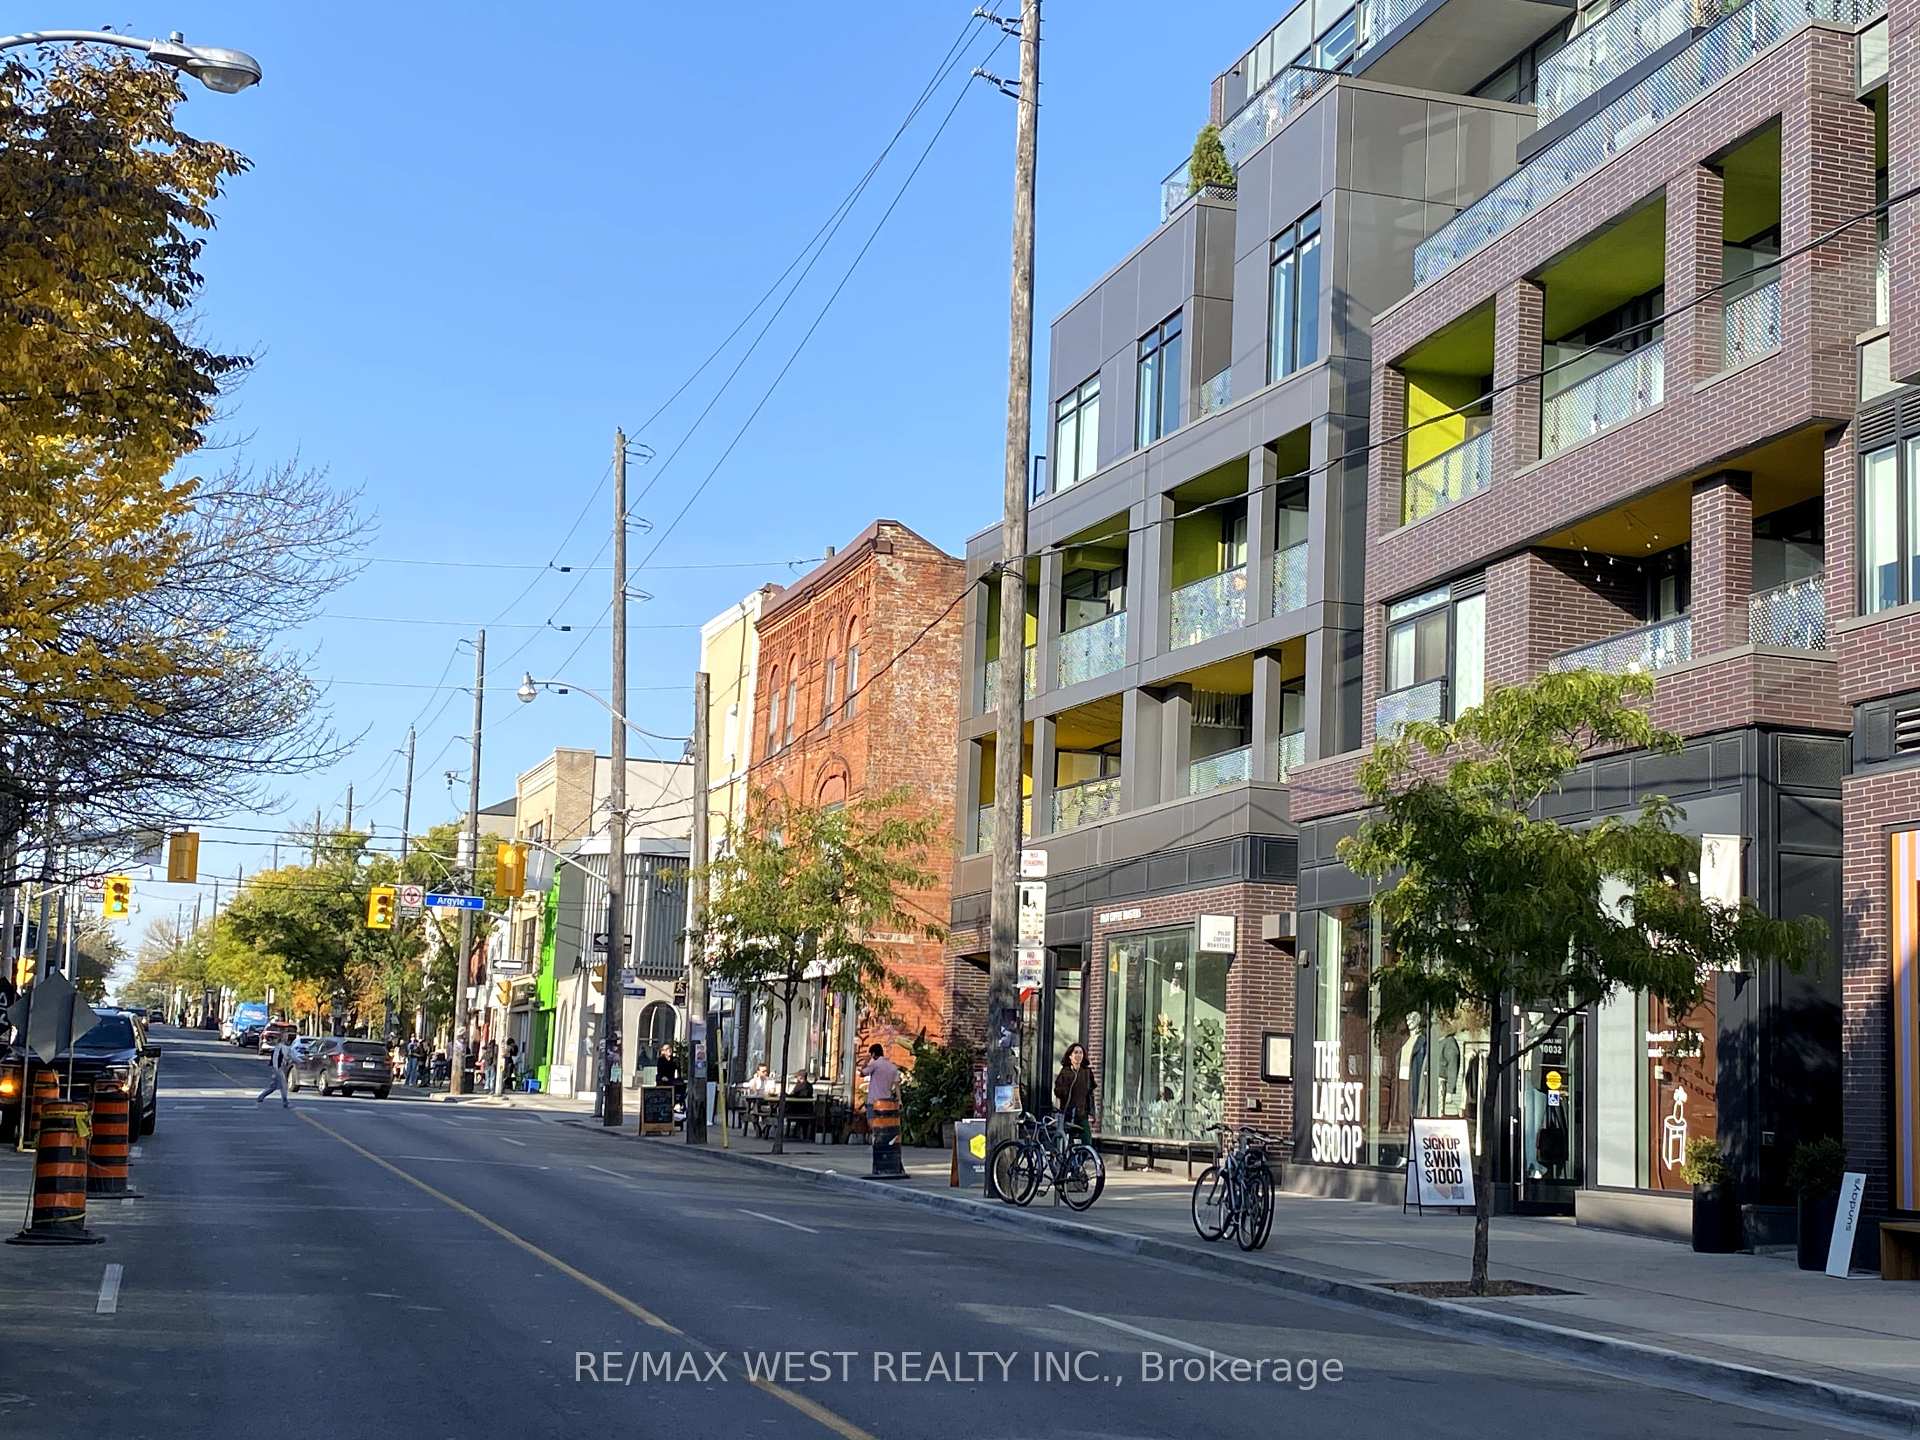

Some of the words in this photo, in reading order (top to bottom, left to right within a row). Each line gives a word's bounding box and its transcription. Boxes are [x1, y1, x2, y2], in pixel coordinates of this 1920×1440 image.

[437, 897, 465, 907] Argyle
[1313, 1040, 1341, 1079] THE
[1312, 1082, 1364, 1121] LATEST
[1312, 1123, 1362, 1165] SCOOP
[1422, 1137, 1446, 1150] SIGN
[1447, 1138, 1461, 1150] UP
[1425, 1168, 1464, 1184] $1000
[1845, 1177, 1861, 1232] sundays
